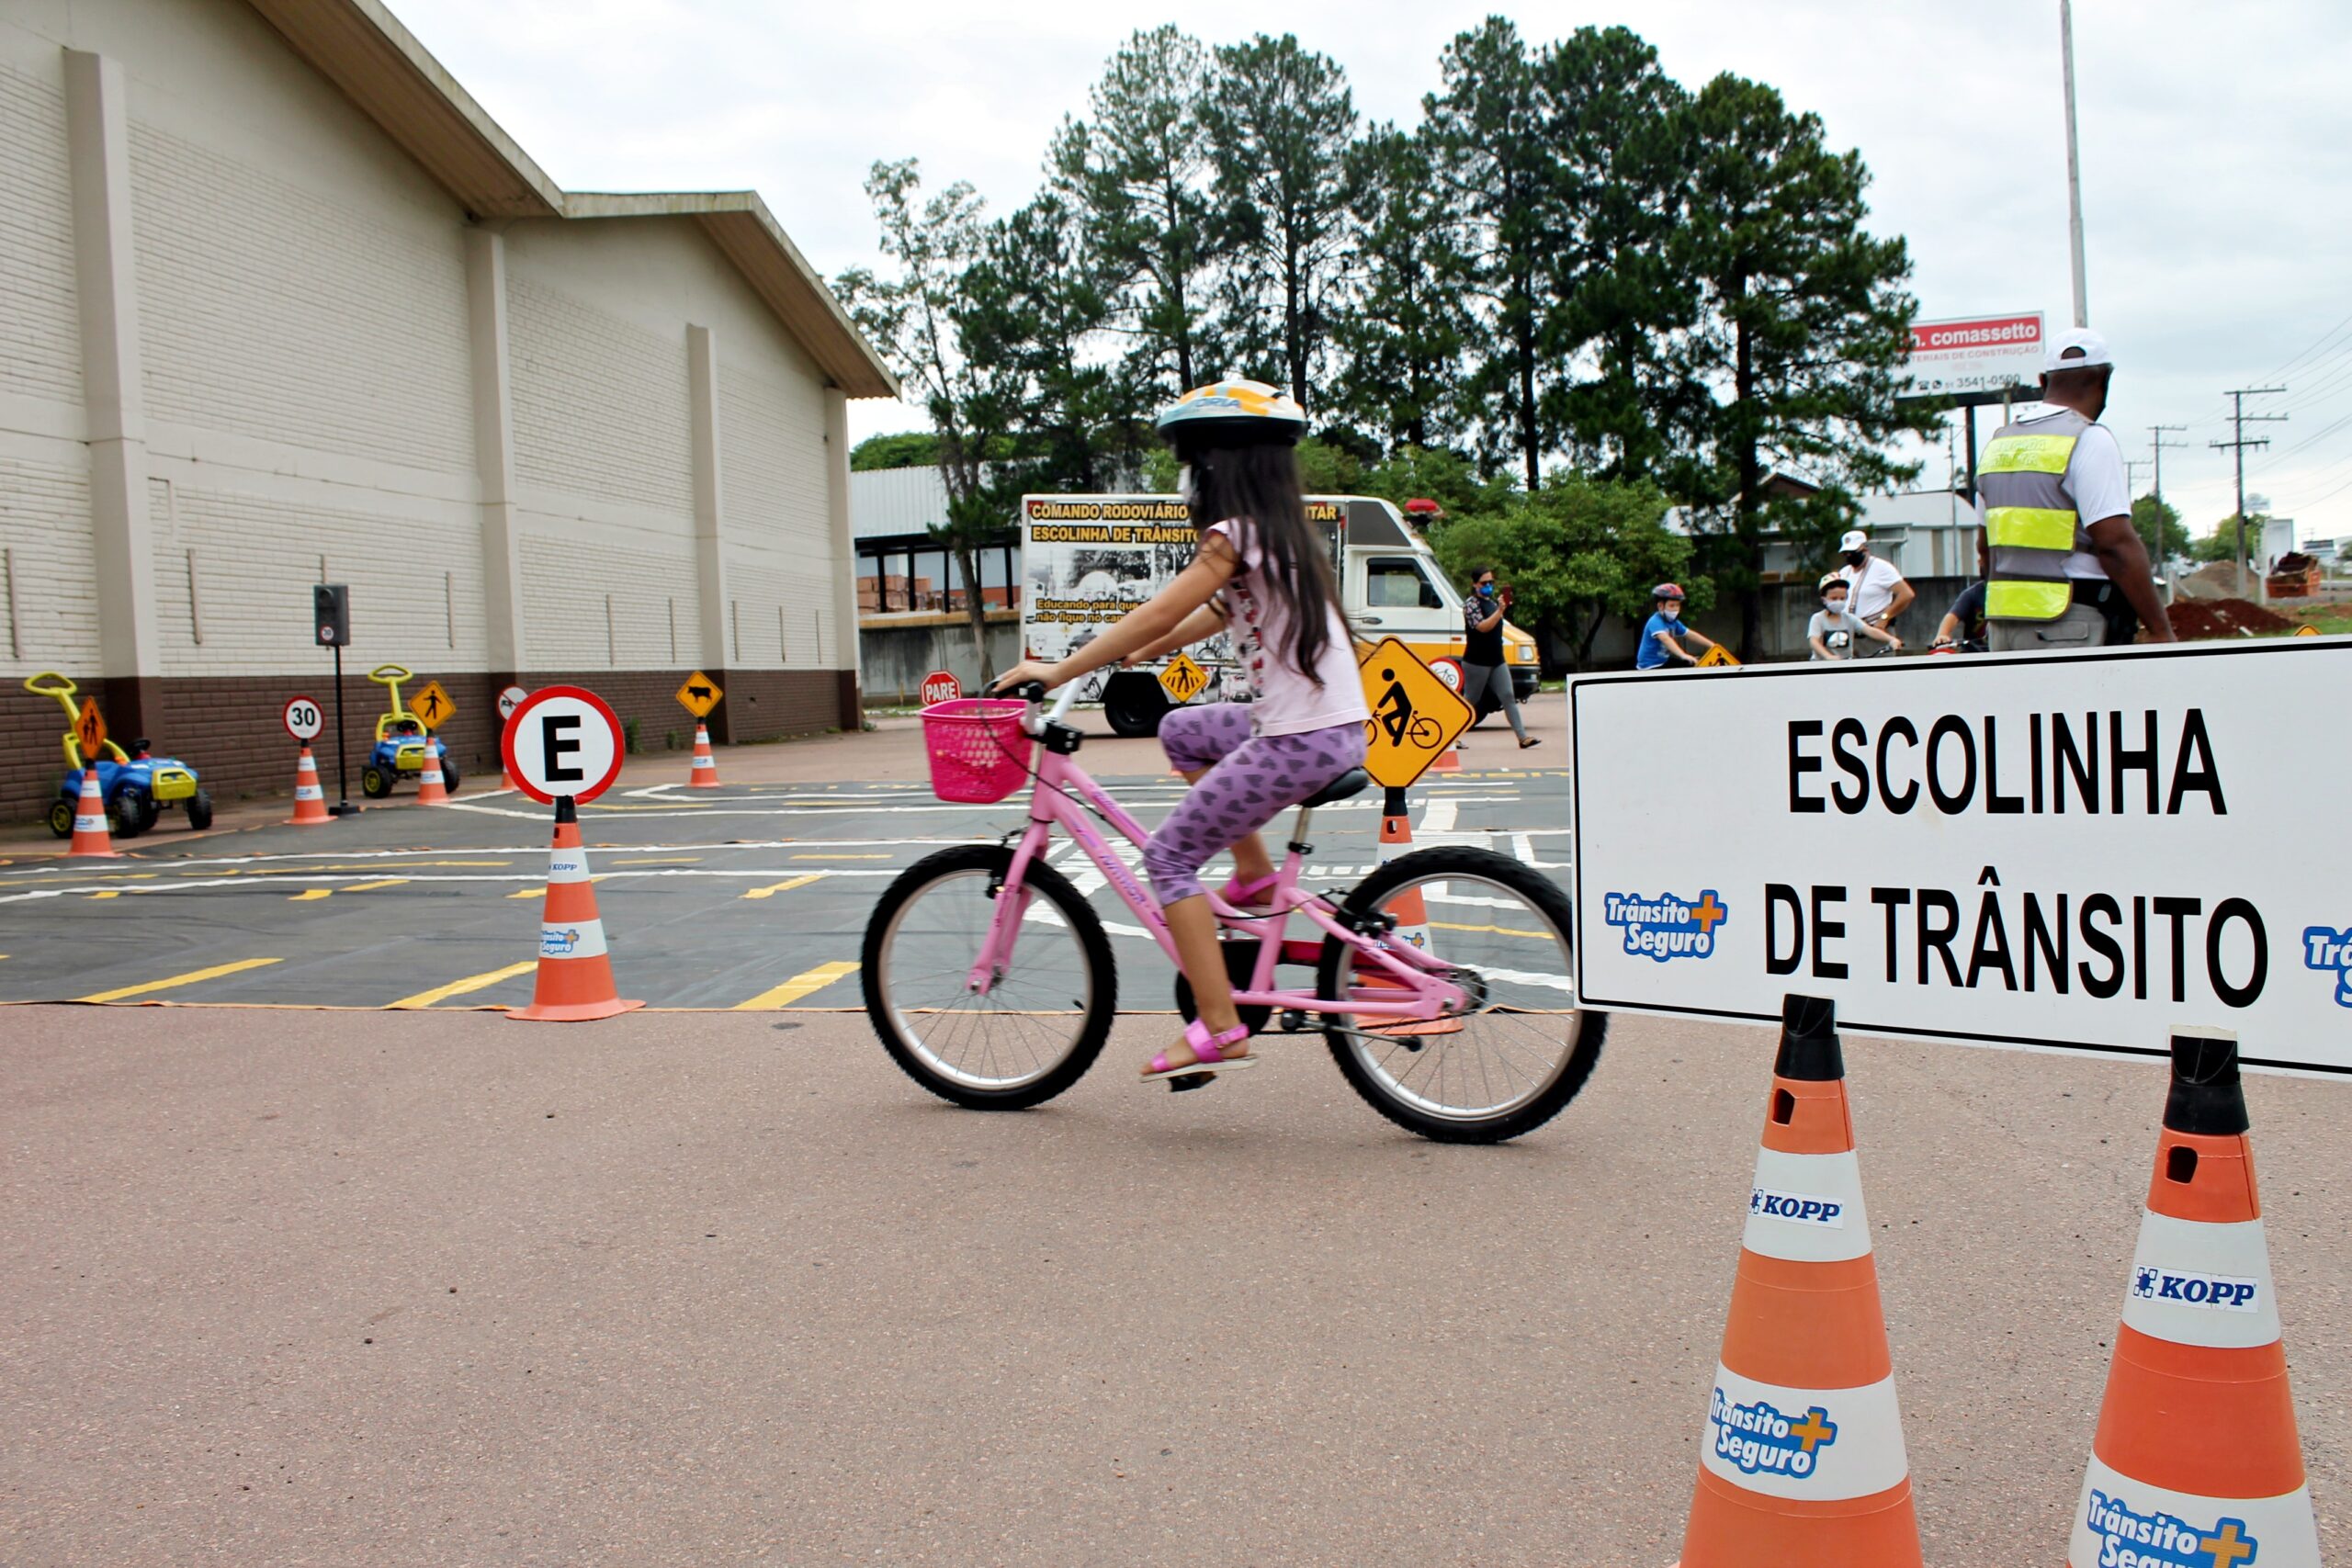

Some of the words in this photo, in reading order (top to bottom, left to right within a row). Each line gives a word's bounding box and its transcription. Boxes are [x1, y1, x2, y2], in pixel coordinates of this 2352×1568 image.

[1931, 322, 2037, 345] comassetto
[1911, 353, 1950, 363] TERIAIS
[1032, 504, 1100, 519] COMANDO
[1102, 502, 1189, 520] RODOVIÁRIO
[1305, 505, 1337, 521] ITAR
[1032, 525, 1110, 542] ESCOLINHA
[1113, 527, 1131, 542] DE
[1036, 599, 1090, 609] Educando
[1092, 601, 1116, 612] para
[1118, 602, 1138, 613] que
[1036, 613, 1056, 622] não
[1057, 612, 1085, 624] fique
[1088, 614, 1102, 622] no
[925, 682, 956, 702] PARE
[292, 707, 315, 727] 30
[542, 715, 584, 783] E
[1788, 708, 2228, 816] ESCOLINHA
[1607, 897, 1690, 924] Trânsito
[1626, 922, 1710, 957] Seguro
[1765, 883, 1849, 980] DE
[1871, 865, 2268, 1009] TRÂNSITO
[1762, 1194, 1840, 1222] KOPP
[2157, 1275, 2255, 1307] KOPP
[1717, 1424, 1811, 1473] Seguro
[2088, 1494, 2199, 1555] Trânsito
